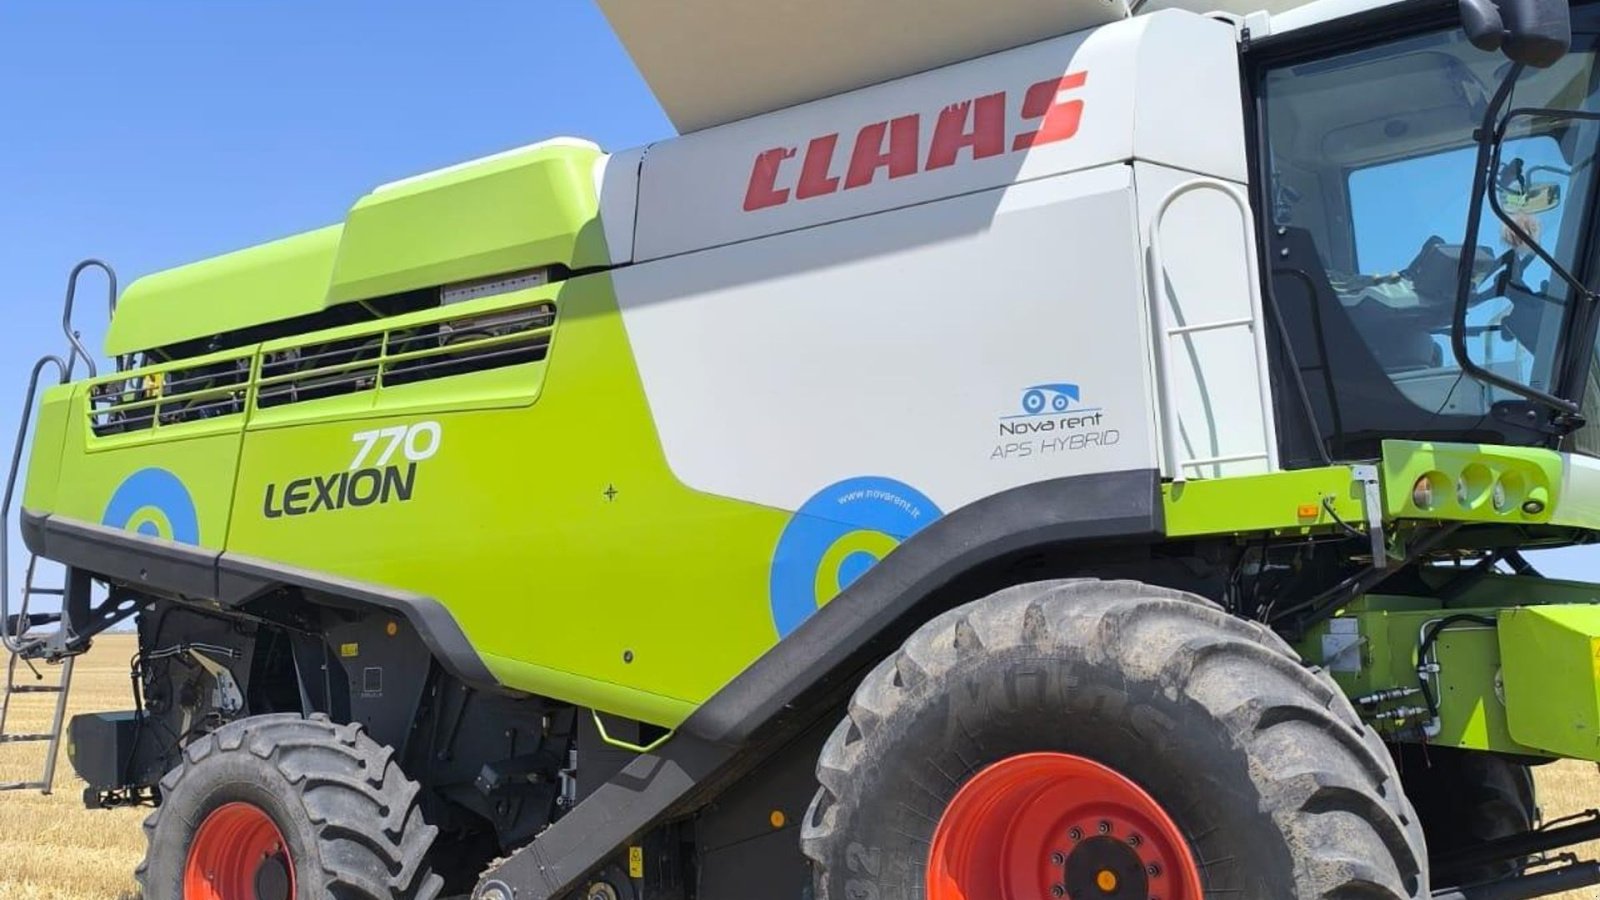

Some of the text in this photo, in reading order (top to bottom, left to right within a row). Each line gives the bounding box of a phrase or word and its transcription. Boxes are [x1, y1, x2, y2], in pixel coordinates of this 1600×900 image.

[743, 71, 1088, 212] CLAAS
[999, 412, 1103, 436] Nova rent
[351, 421, 442, 469] 770
[990, 430, 1120, 460] APS HYBRID
[263, 462, 417, 518] LEXION
[837, 489, 920, 520] www.novarent.lt
